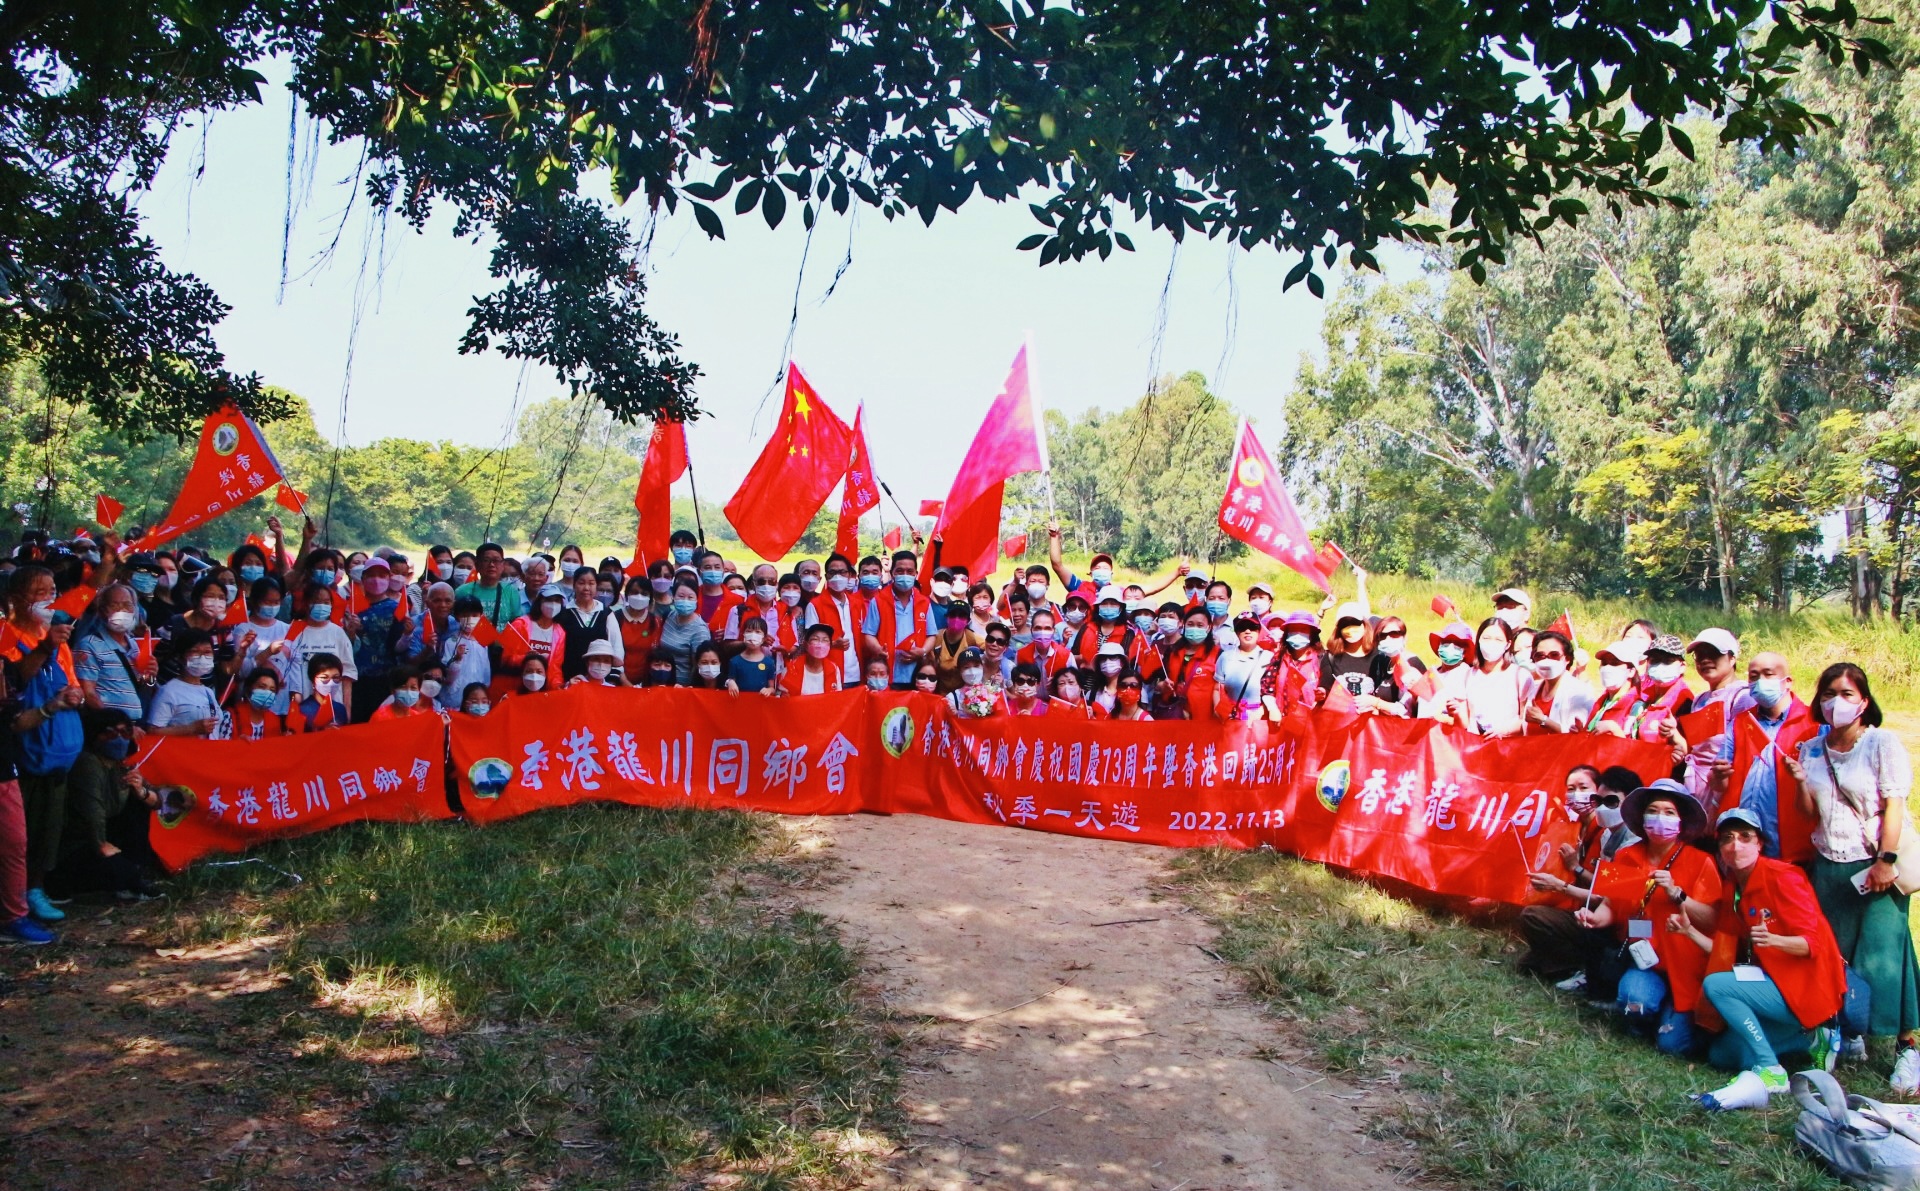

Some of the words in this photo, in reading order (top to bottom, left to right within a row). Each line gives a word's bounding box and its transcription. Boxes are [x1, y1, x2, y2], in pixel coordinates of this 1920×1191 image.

[1230, 487, 1262, 513] 香港
[520, 726, 859, 800] 香港龍川同鄉會
[206, 757, 430, 825] 香港龍川同鄉會
[983, 792, 1141, 832] 秋季一天遊
[1355, 768, 1548, 839] 香港龍川同
[1168, 809, 1285, 831] 2022.11.13
